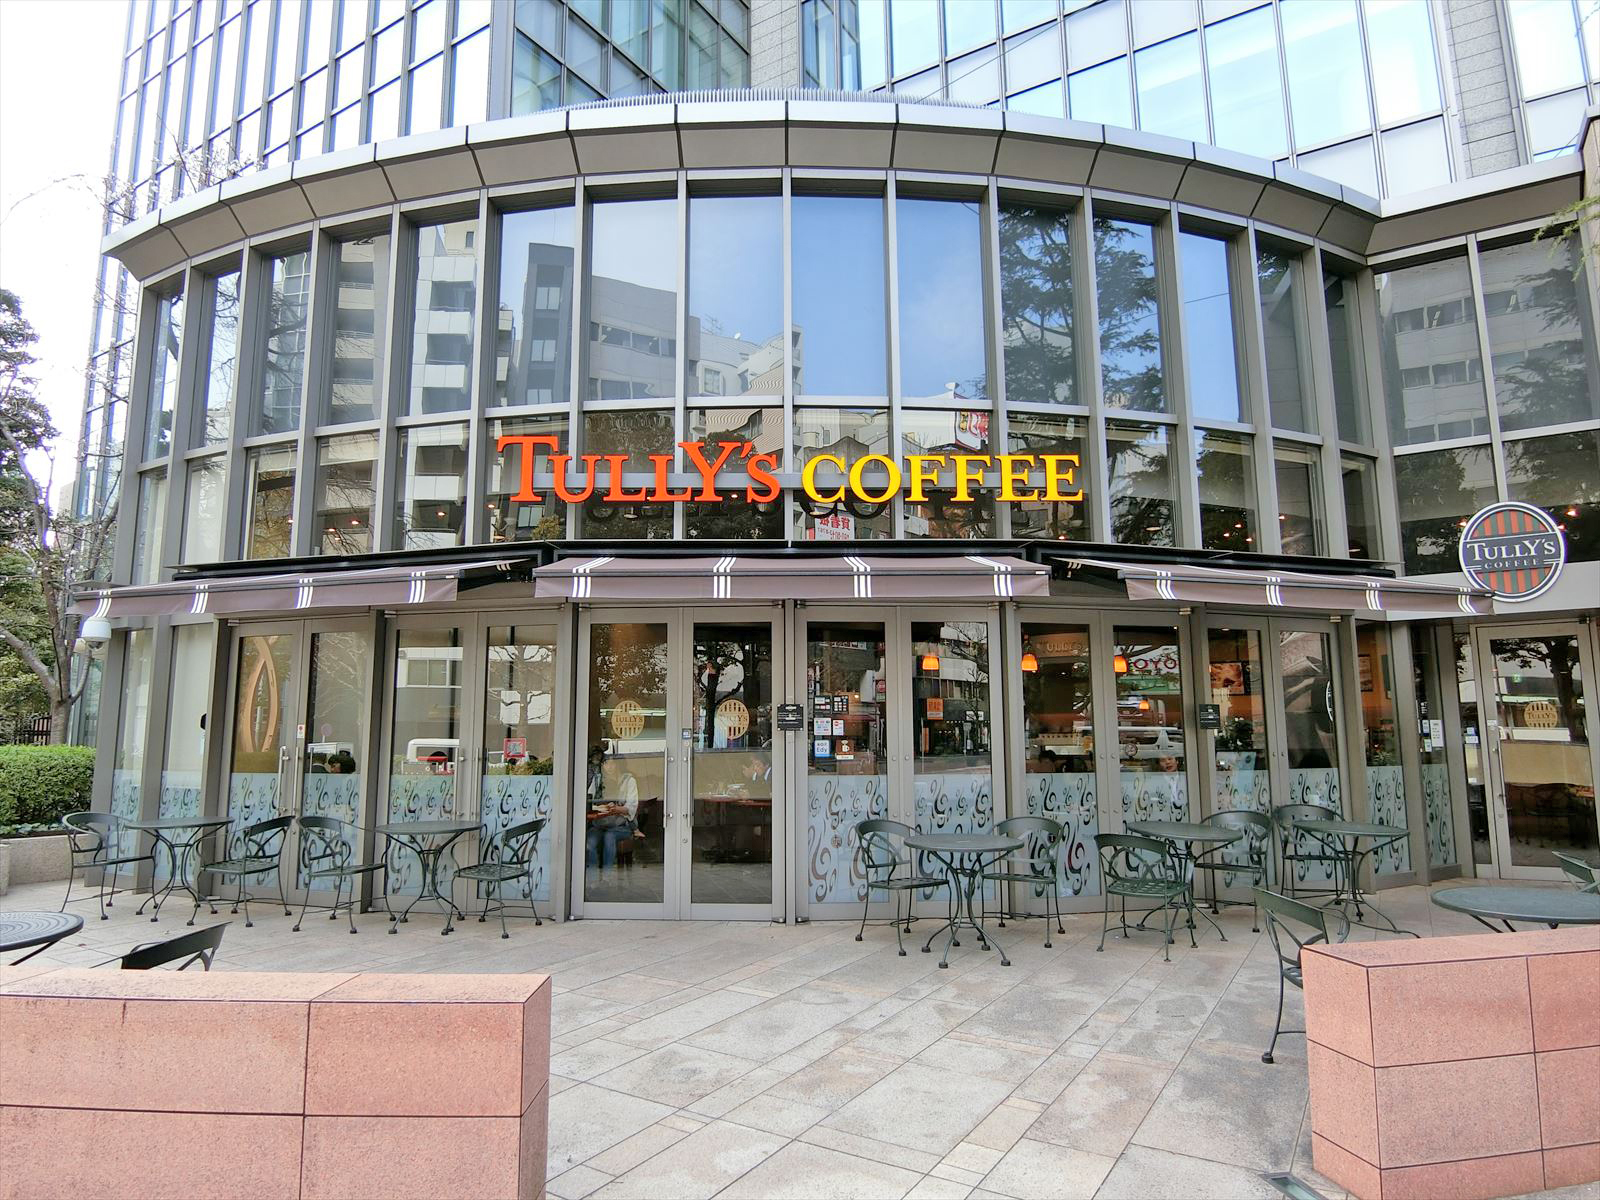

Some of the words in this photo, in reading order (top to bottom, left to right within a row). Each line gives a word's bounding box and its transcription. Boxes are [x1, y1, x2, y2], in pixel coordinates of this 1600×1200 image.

[497, 435, 781, 503] TULLY'S
[801, 454, 1084, 504] COFFEE
[1467, 538, 1556, 561] TULLY'S
[1484, 558, 1540, 570] COFFEE
